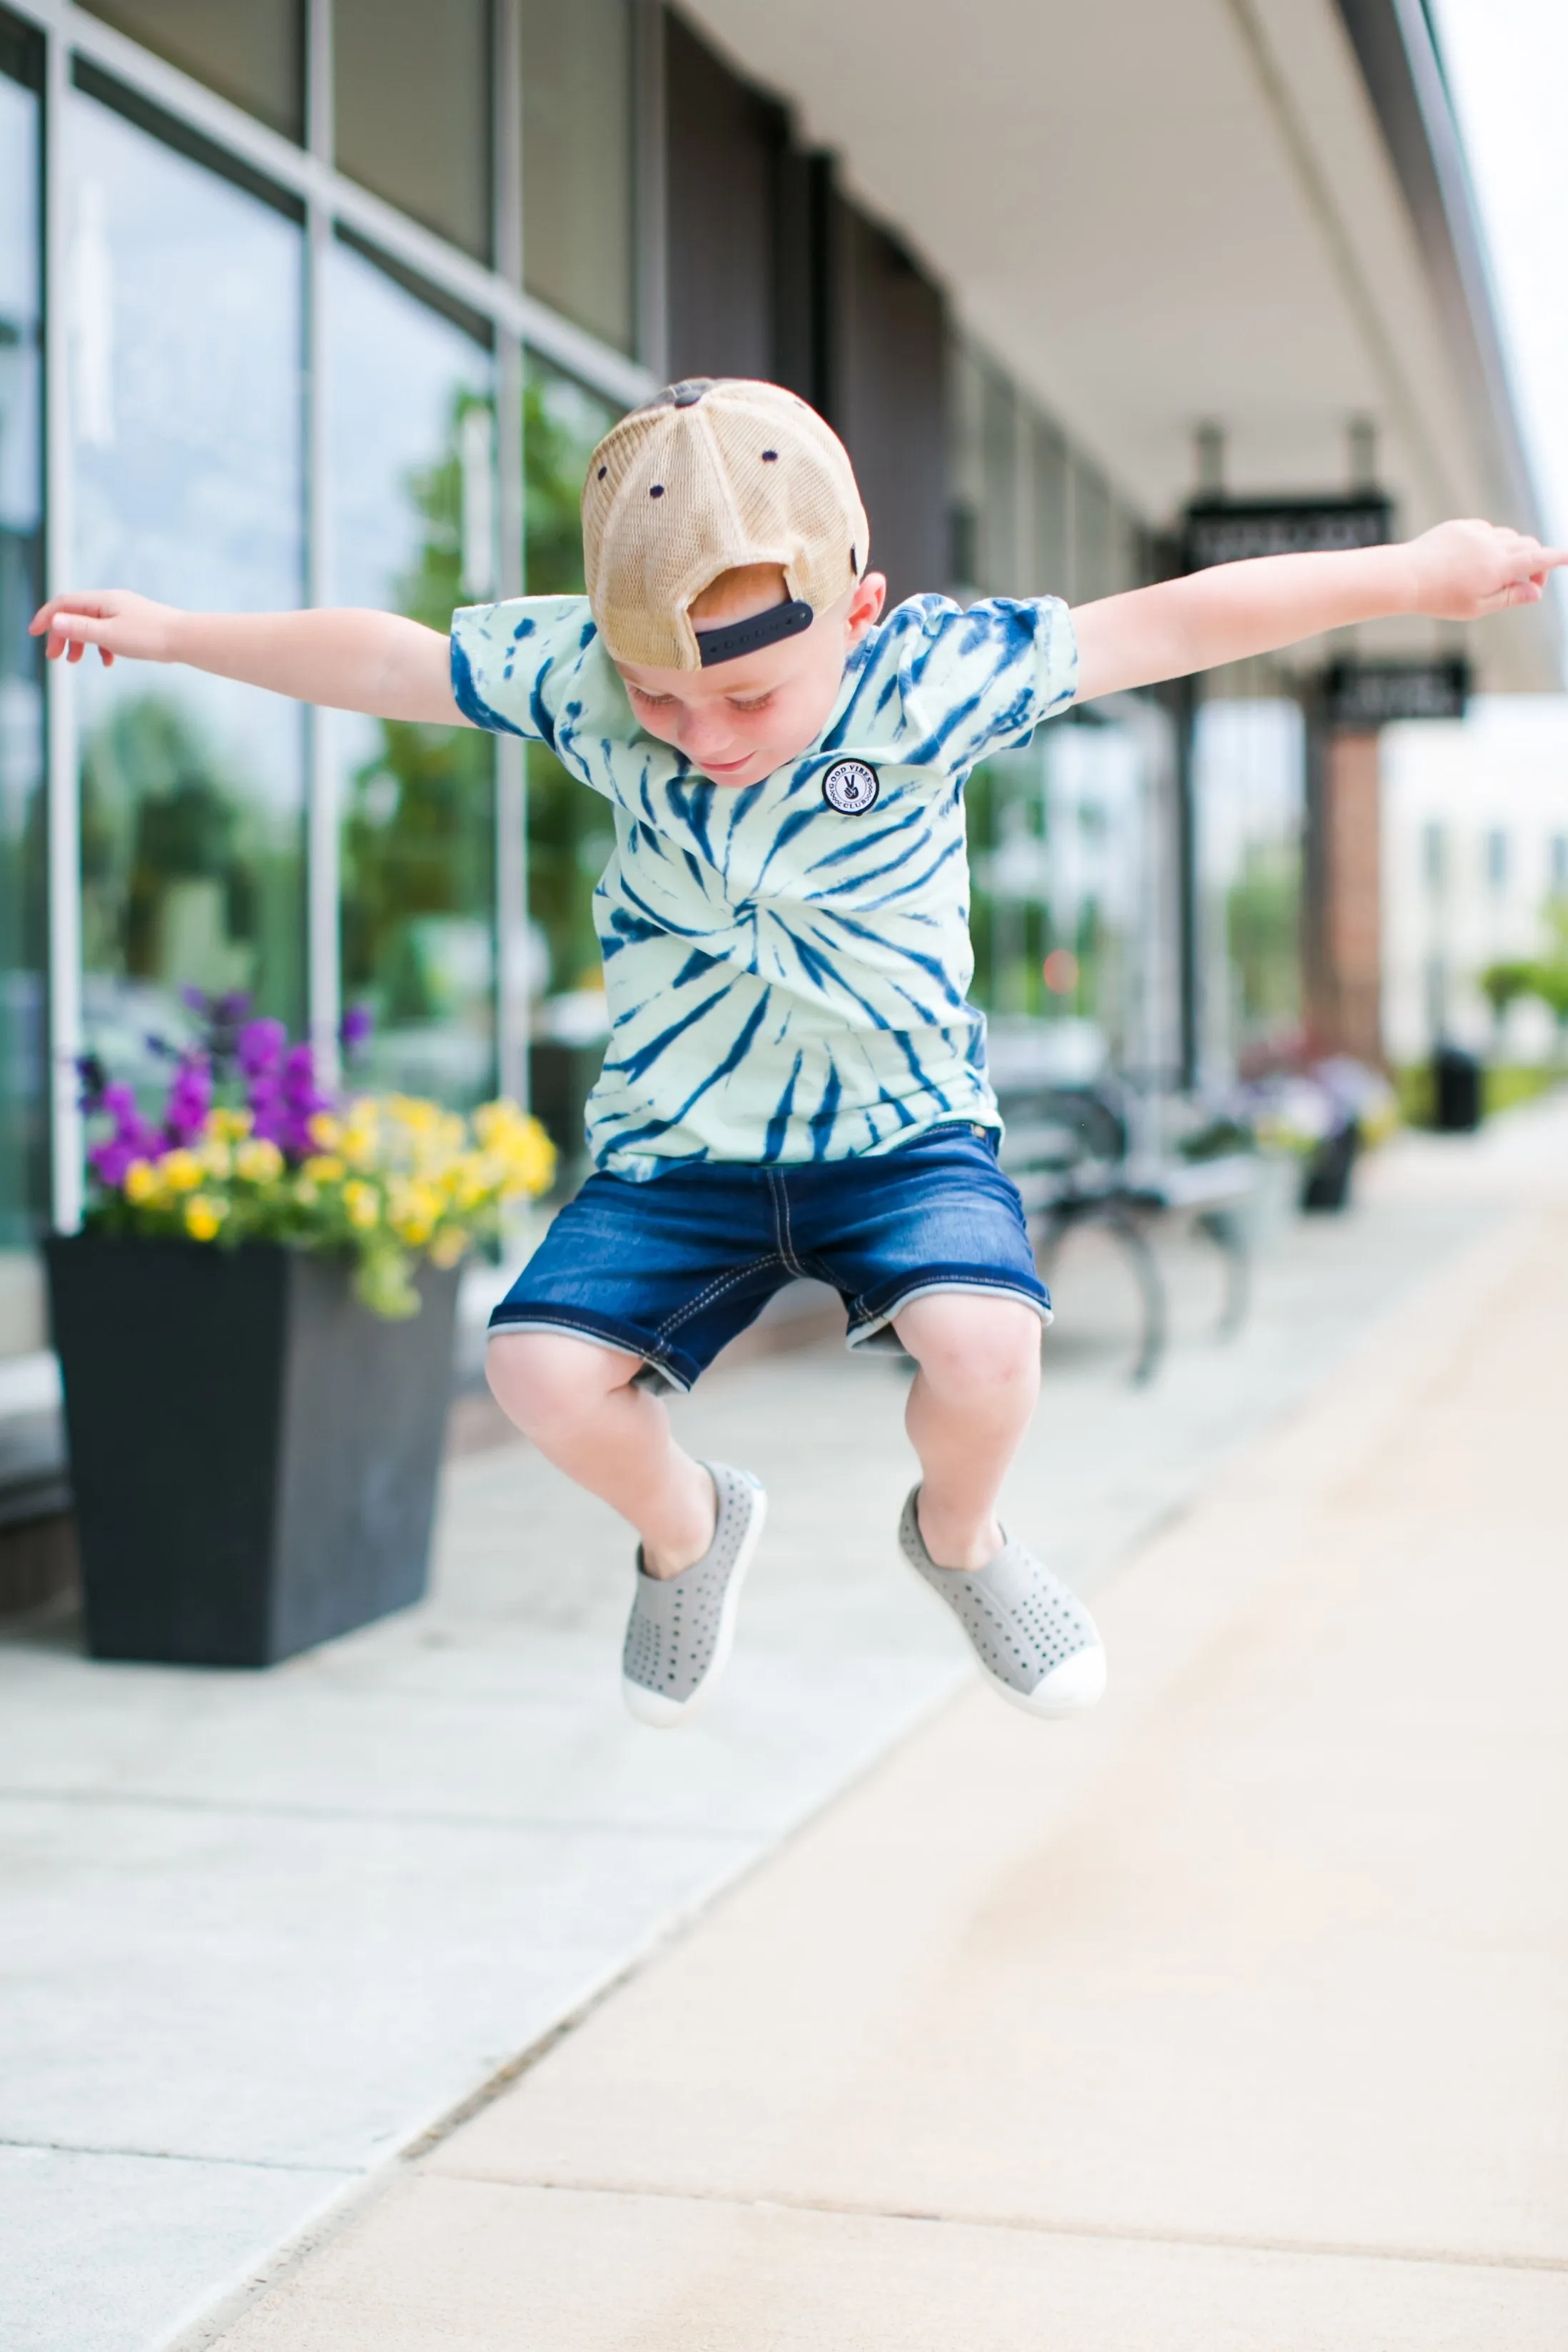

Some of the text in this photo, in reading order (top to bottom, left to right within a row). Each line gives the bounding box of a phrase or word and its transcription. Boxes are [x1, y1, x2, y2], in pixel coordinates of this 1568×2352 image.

[829, 765, 872, 789] GOOD VIBES
[843, 799, 866, 809] CLUB
